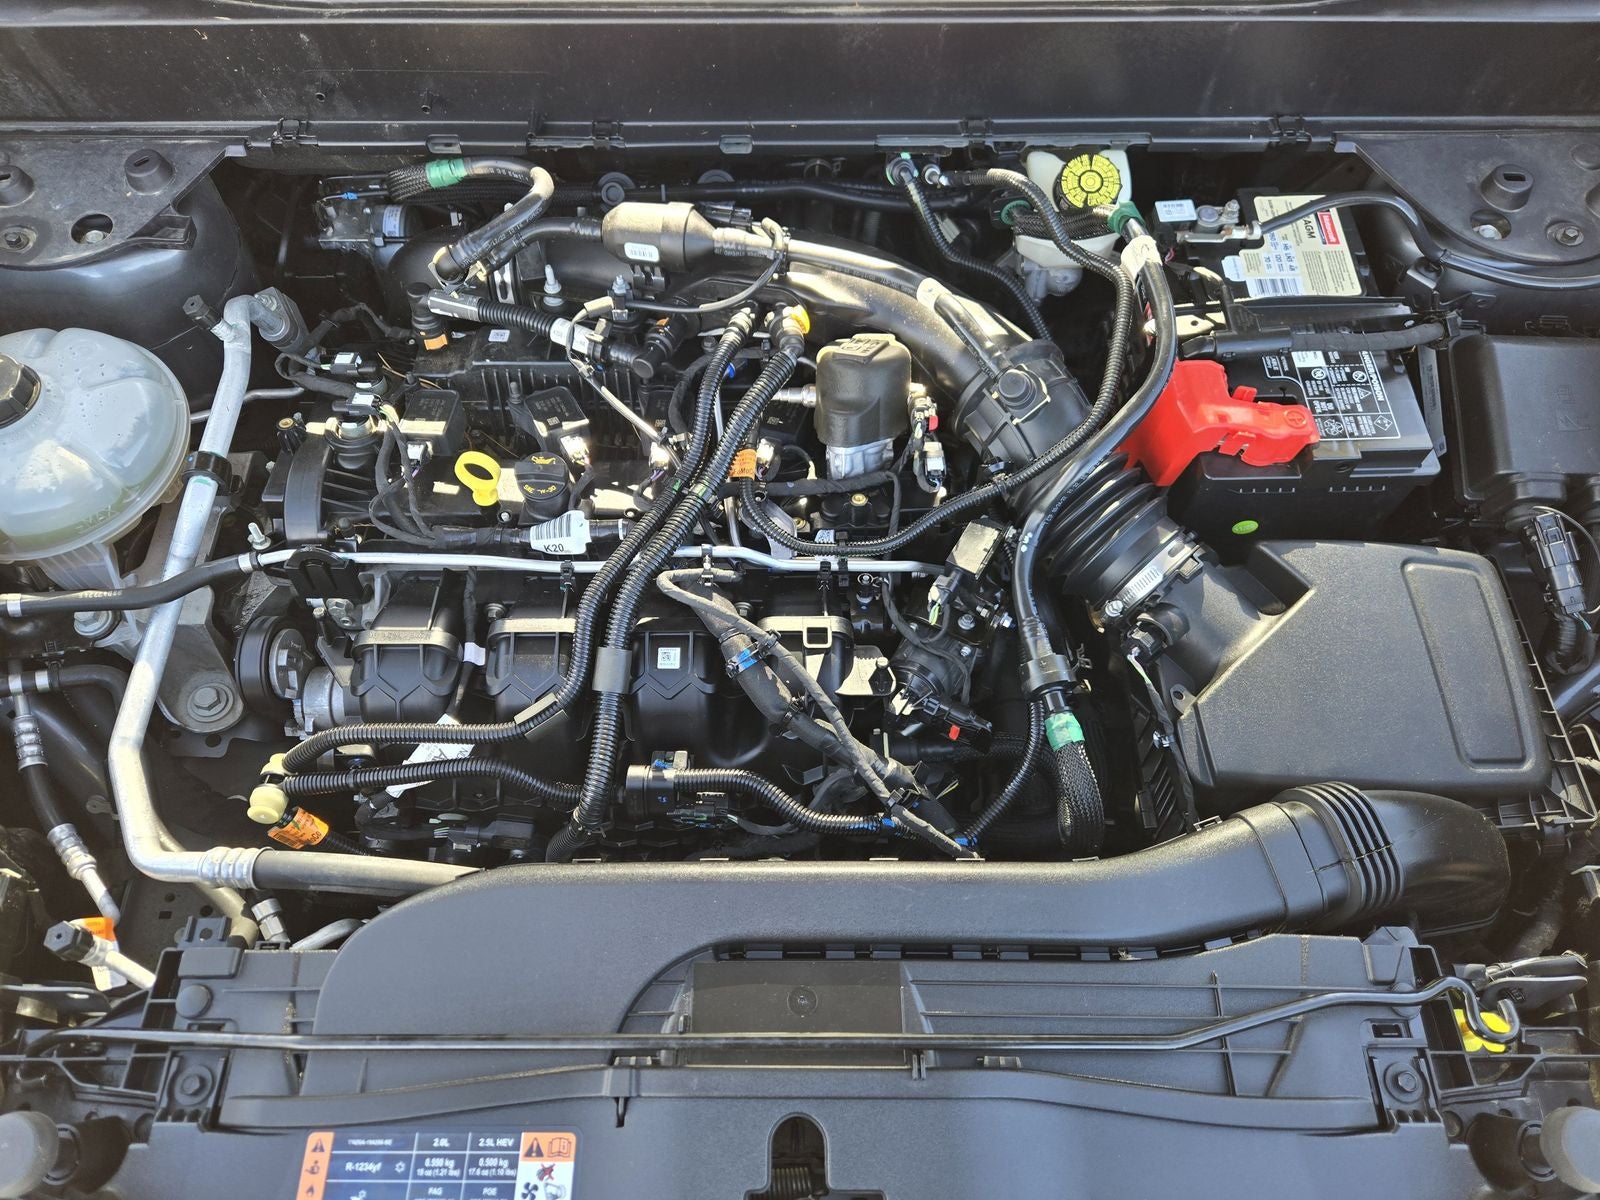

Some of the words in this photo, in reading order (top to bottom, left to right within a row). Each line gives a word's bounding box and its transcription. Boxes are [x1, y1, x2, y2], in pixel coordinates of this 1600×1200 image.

[1302, 219, 1316, 239] AGM
[1361, 350, 1384, 401] ANGER/POISON
[544, 544, 564, 552] K20
[478, 1138, 494, 1148] 2.5L
[496, 1138, 514, 1148] HEV
[345, 1161, 382, 1174] R-1234yf
[444, 1158, 455, 1170] kg
[499, 1158, 509, 1170] kg
